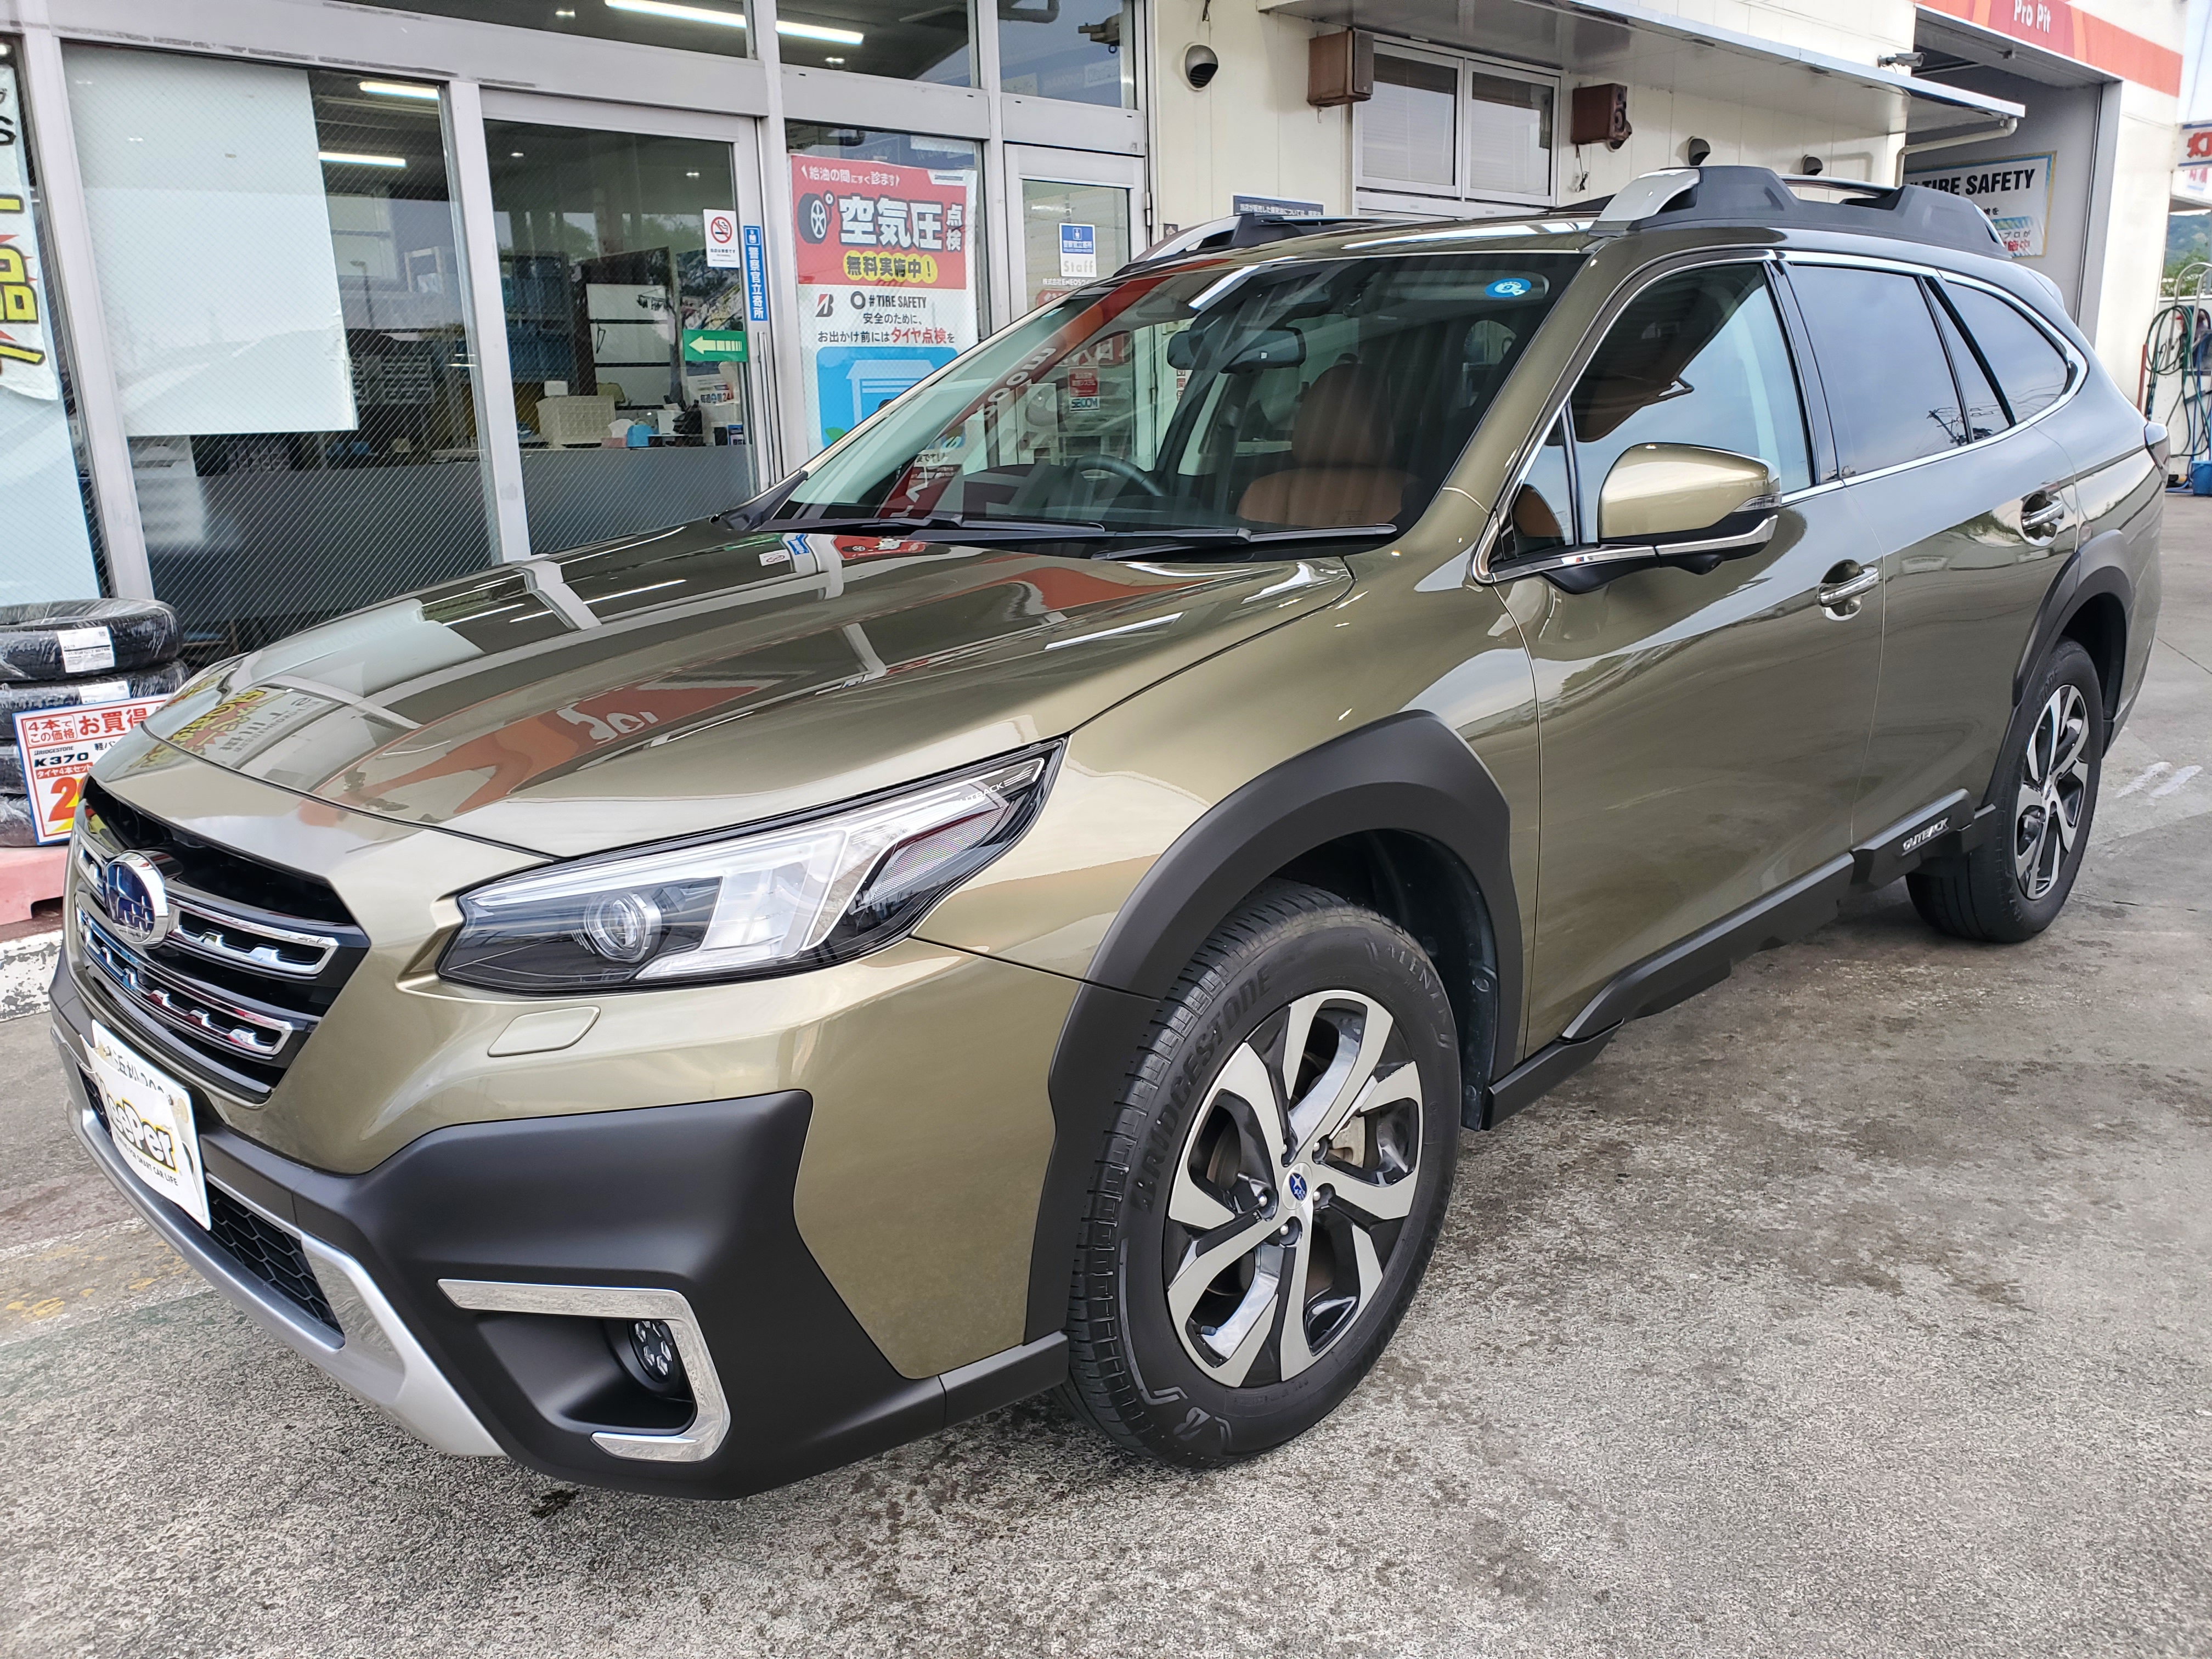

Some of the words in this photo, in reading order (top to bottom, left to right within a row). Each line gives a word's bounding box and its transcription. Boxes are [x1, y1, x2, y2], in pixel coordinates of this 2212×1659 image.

[2013, 0, 2033, 27] Pro
[2036, 2, 2051, 33] Pit
[1965, 168, 2036, 195] SAFETY
[838, 195, 944, 250] 空気圧
[946, 204, 963, 252] 点検
[1063, 259, 1093, 273] Staff
[747, 246, 765, 319] 警察官立寄所
[898, 296, 927, 309] SAFETY
[862, 312, 922, 325] 安全のために、
[817, 328, 955, 345] お出かけ前にはタイヤ点検を
[28, 719, 72, 732] 4本で
[78, 706, 159, 736] お買得
[30, 728, 75, 744] この価格
[33, 745, 75, 756] BRIDGESTONE
[33, 752, 89, 768] K370
[37, 764, 93, 778] タイヤ4本セット
[1129, 963, 1272, 1215] BRIDGESTONE
[153, 1165, 165, 1181] CAR
[165, 1173, 178, 1192] LIFE
